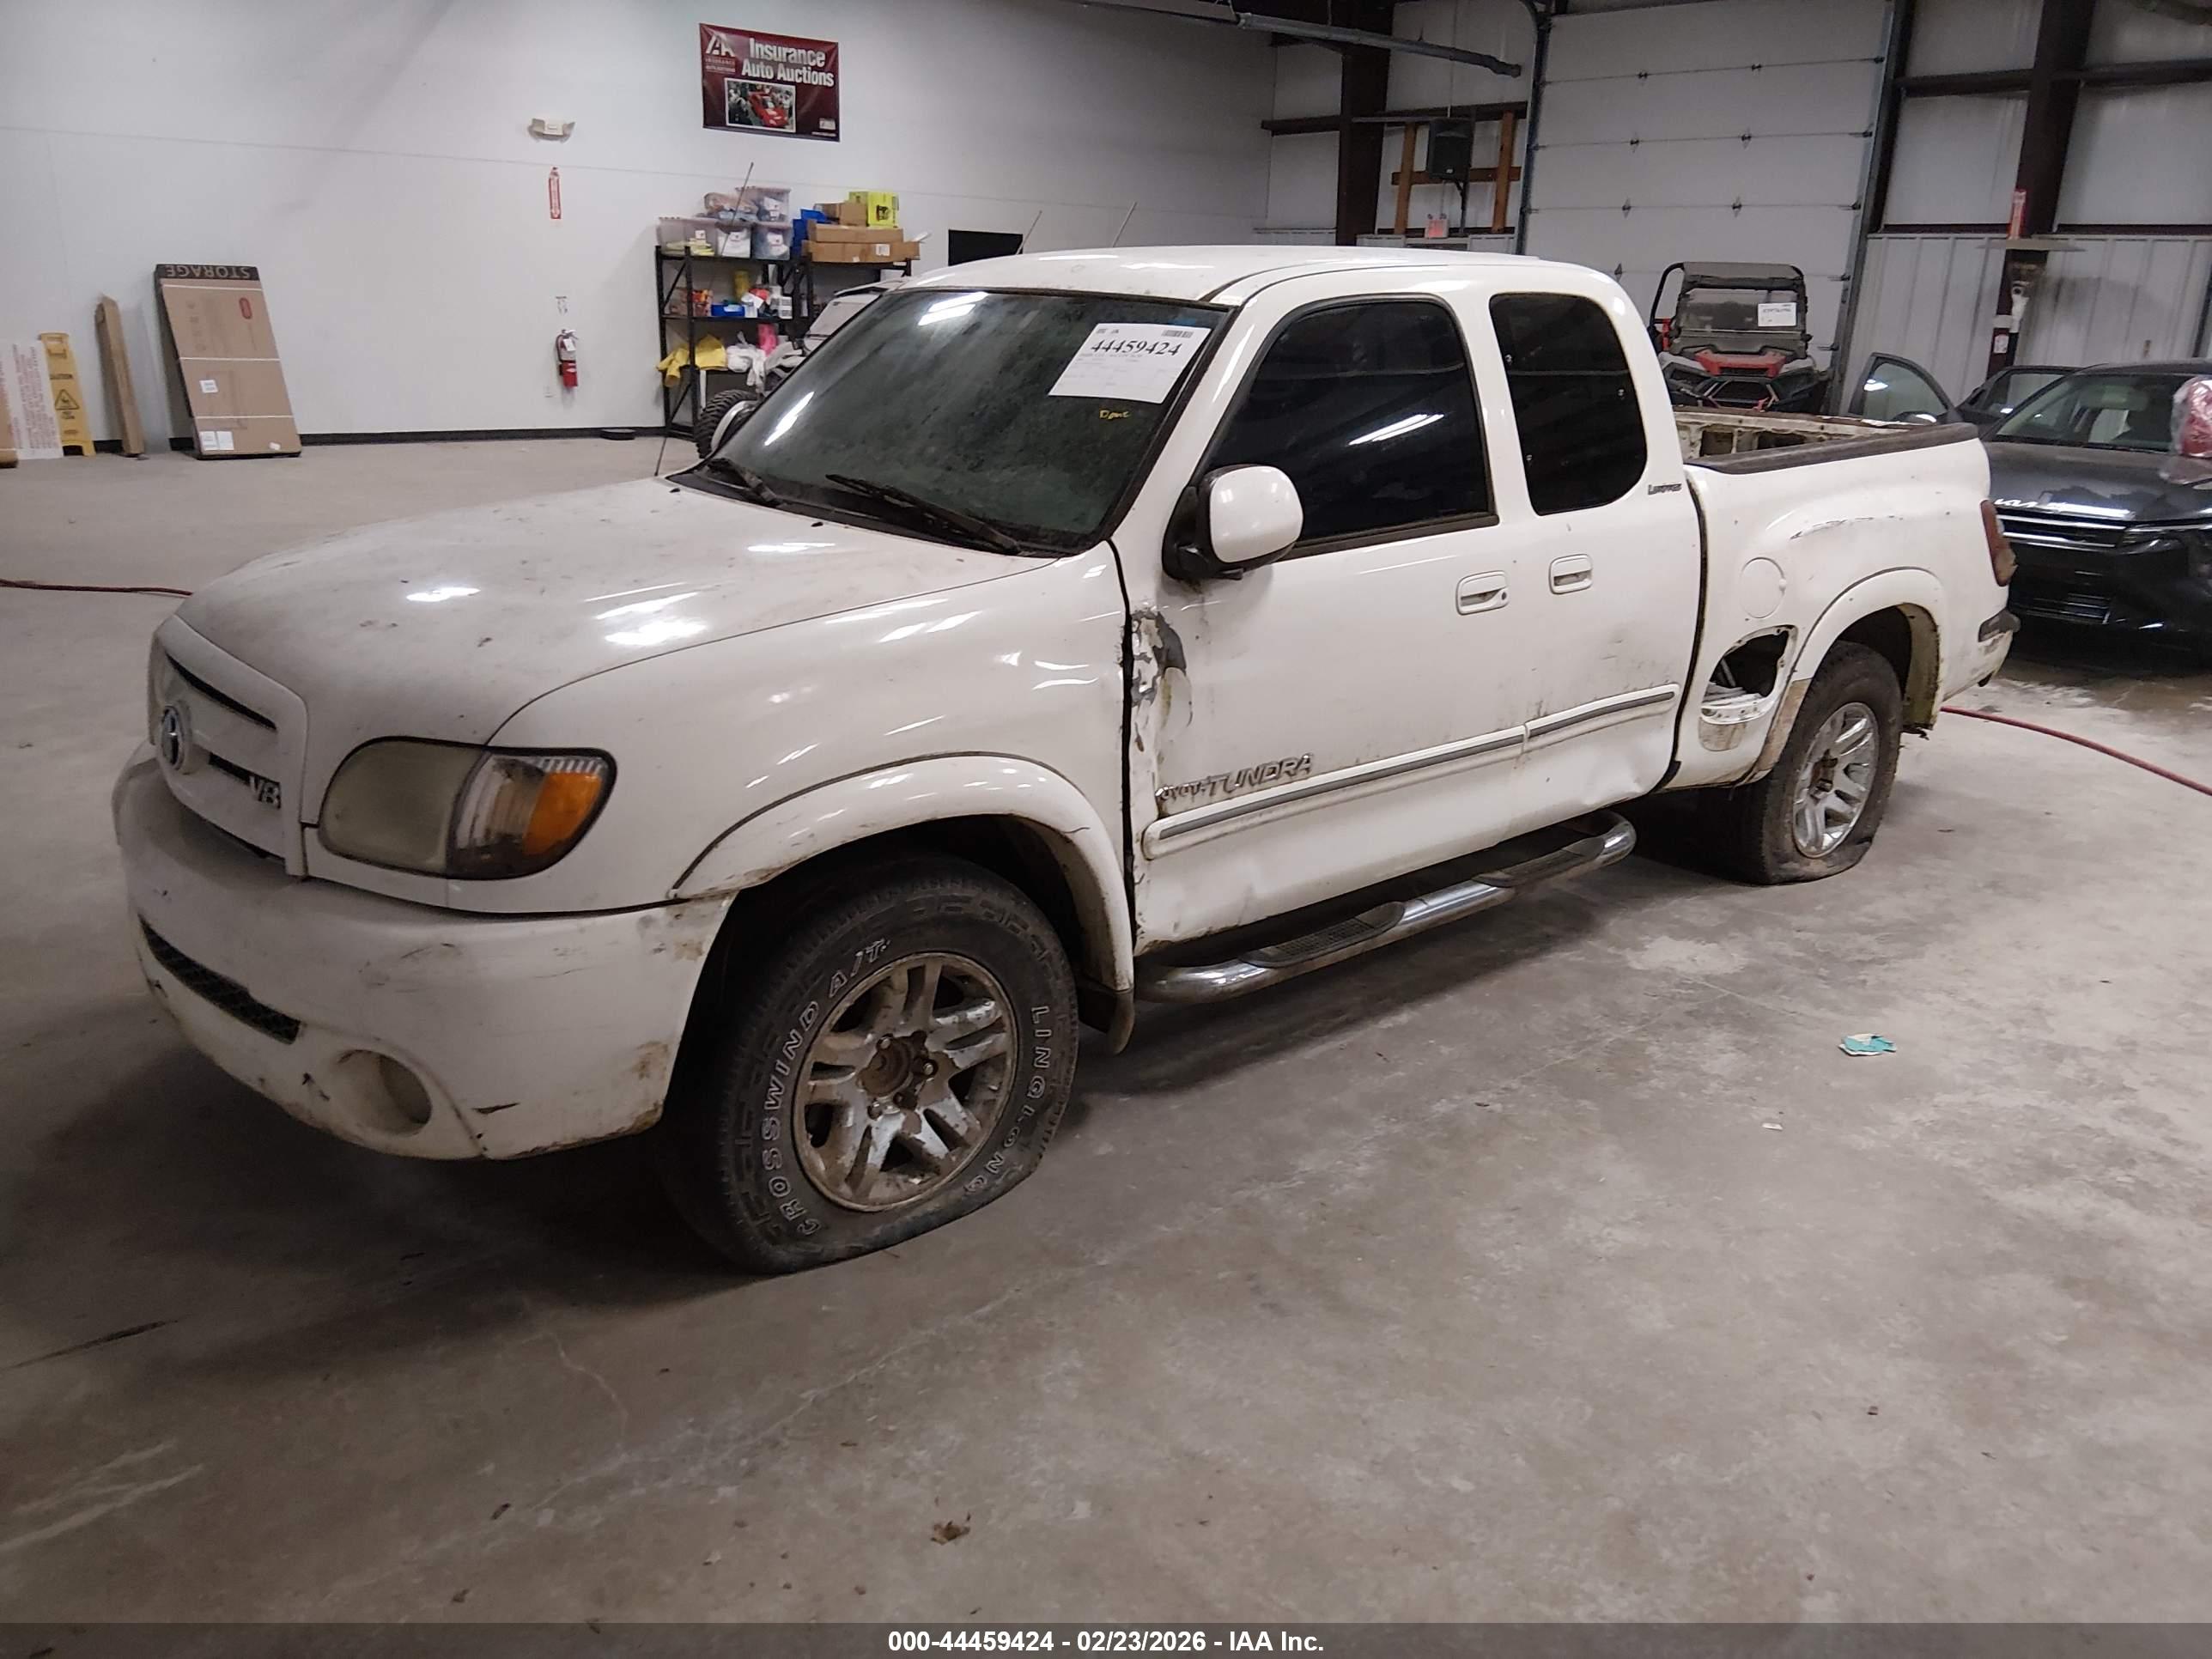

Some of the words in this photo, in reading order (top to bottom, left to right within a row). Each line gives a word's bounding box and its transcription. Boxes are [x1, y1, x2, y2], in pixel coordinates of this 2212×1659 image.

[749, 38, 826, 68] Insurance
[741, 58, 774, 79] Auto
[777, 65, 835, 88] Auctions
[164, 264, 252, 279] STORAGE
[1091, 339, 1182, 356] 44459424
[1204, 752, 1314, 797] TUNDRA
[248, 775, 282, 809] V8
[759, 1000, 823, 1237] CROSSWIND
[828, 939, 889, 999] A/T
